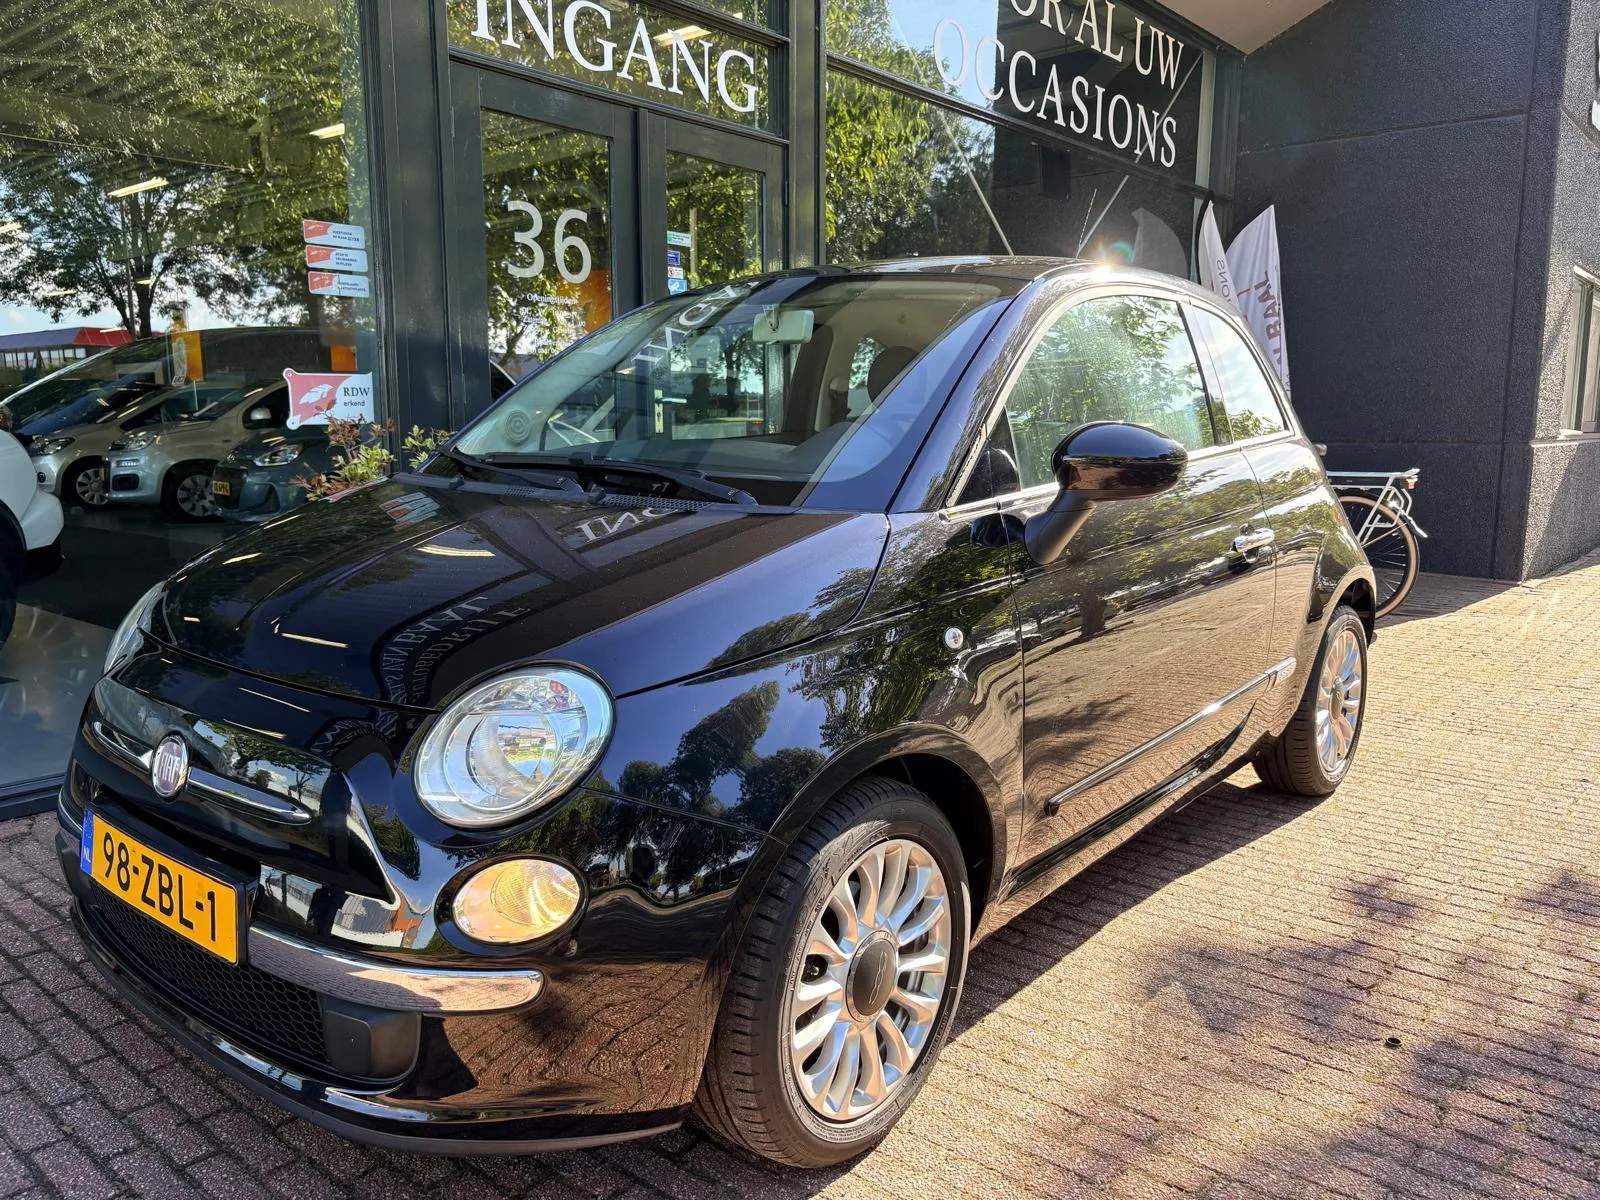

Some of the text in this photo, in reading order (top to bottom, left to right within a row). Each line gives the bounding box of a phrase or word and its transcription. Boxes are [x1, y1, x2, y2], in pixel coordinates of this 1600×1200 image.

[471, 0, 759, 113] INGANG
[1074, 0, 1124, 63] AL
[1134, 17, 1185, 91] UW
[933, 18, 1178, 168] OCCASIONS
[507, 200, 592, 284] 36
[343, 386, 371, 397] RDW
[156, 752, 180, 782] FIAT
[83, 846, 92, 863] NL
[103, 831, 216, 942] 98-ZBL-1
